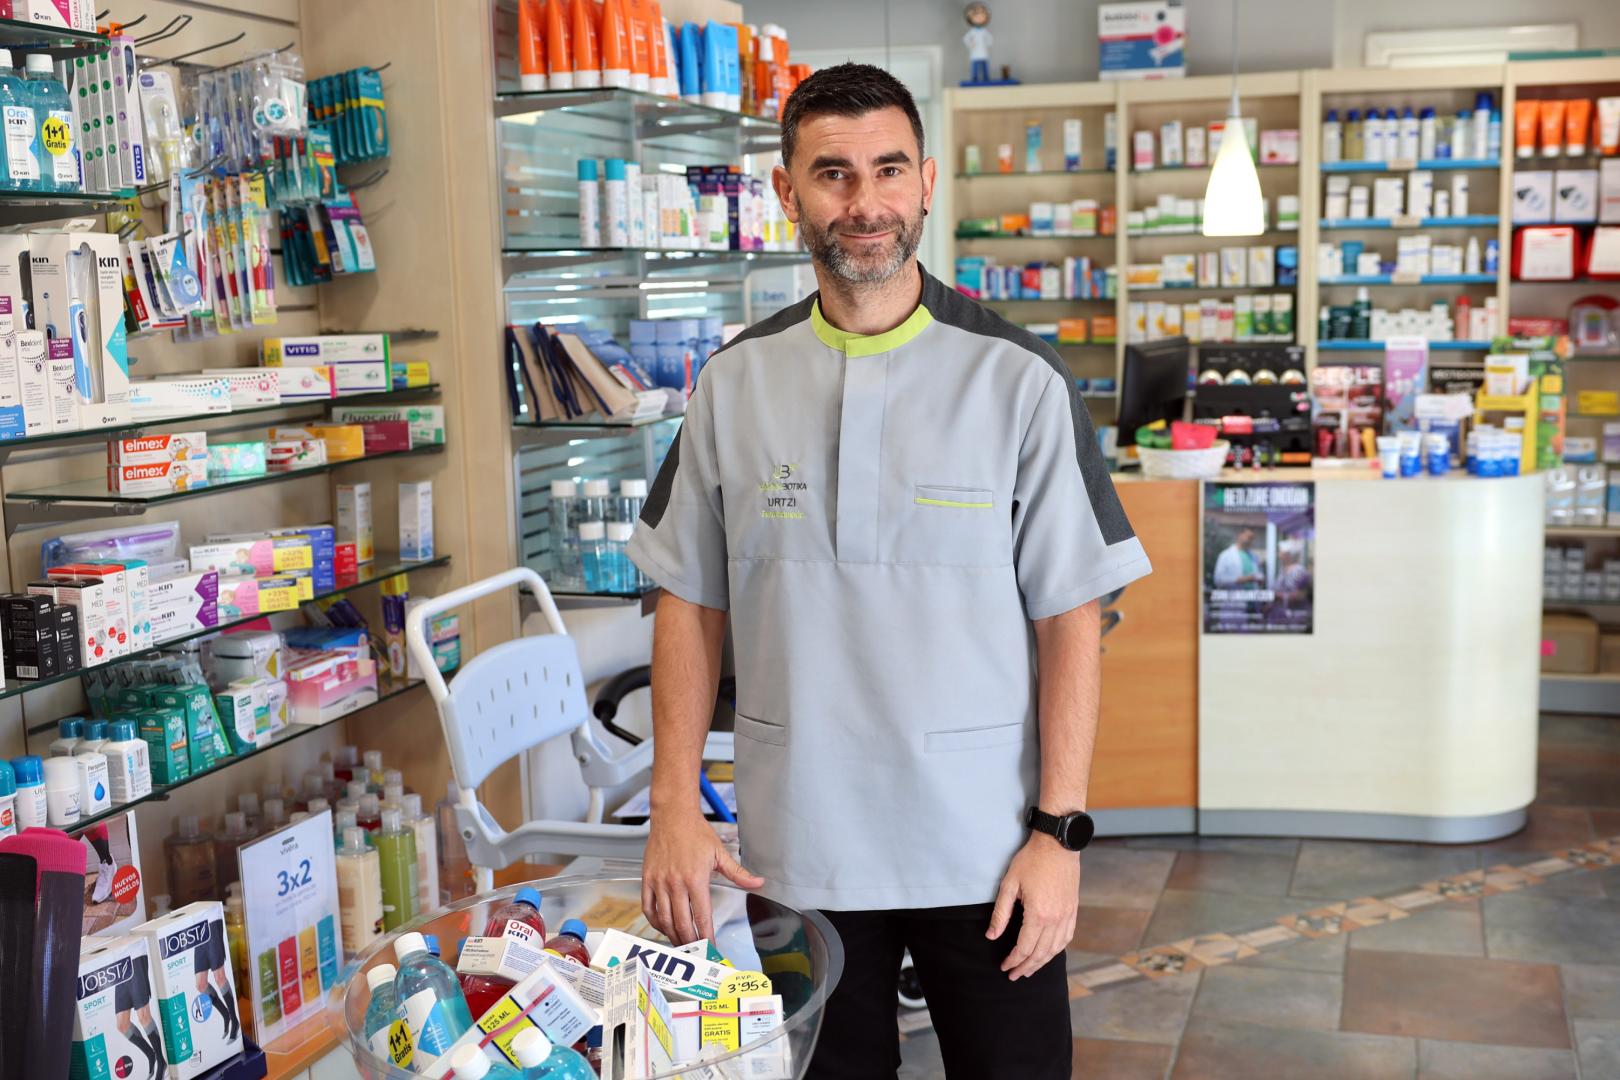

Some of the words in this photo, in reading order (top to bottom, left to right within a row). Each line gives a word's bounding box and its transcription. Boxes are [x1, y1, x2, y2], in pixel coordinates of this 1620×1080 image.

[44, 123, 65, 140] 1+1
[46, 139, 67, 149] Gratis
[135, 146, 145, 180] VITIS
[286, 344, 319, 356] VITIS
[125, 439, 164, 452] elmex
[125, 466, 164, 479] elmex
[767, 497, 796, 507] URTZI
[114, 872, 137, 891] NUEVOS
[277, 858, 313, 897] 3x2
[114, 879, 141, 899] MODELOS
[509, 919, 534, 938] Oral
[164, 924, 202, 958] JOBST
[167, 956, 187, 971] SPORT
[80, 961, 124, 999] JOBST
[650, 971, 679, 986] ENTIFRICA
[83, 995, 107, 1012] SPORT
[487, 1020, 501, 1031] 125
[498, 1010, 511, 1021] ML
[389, 1023, 408, 1053] 1+1
[704, 1029, 731, 1037] GRATIS
[394, 1043, 412, 1064] Gratis
